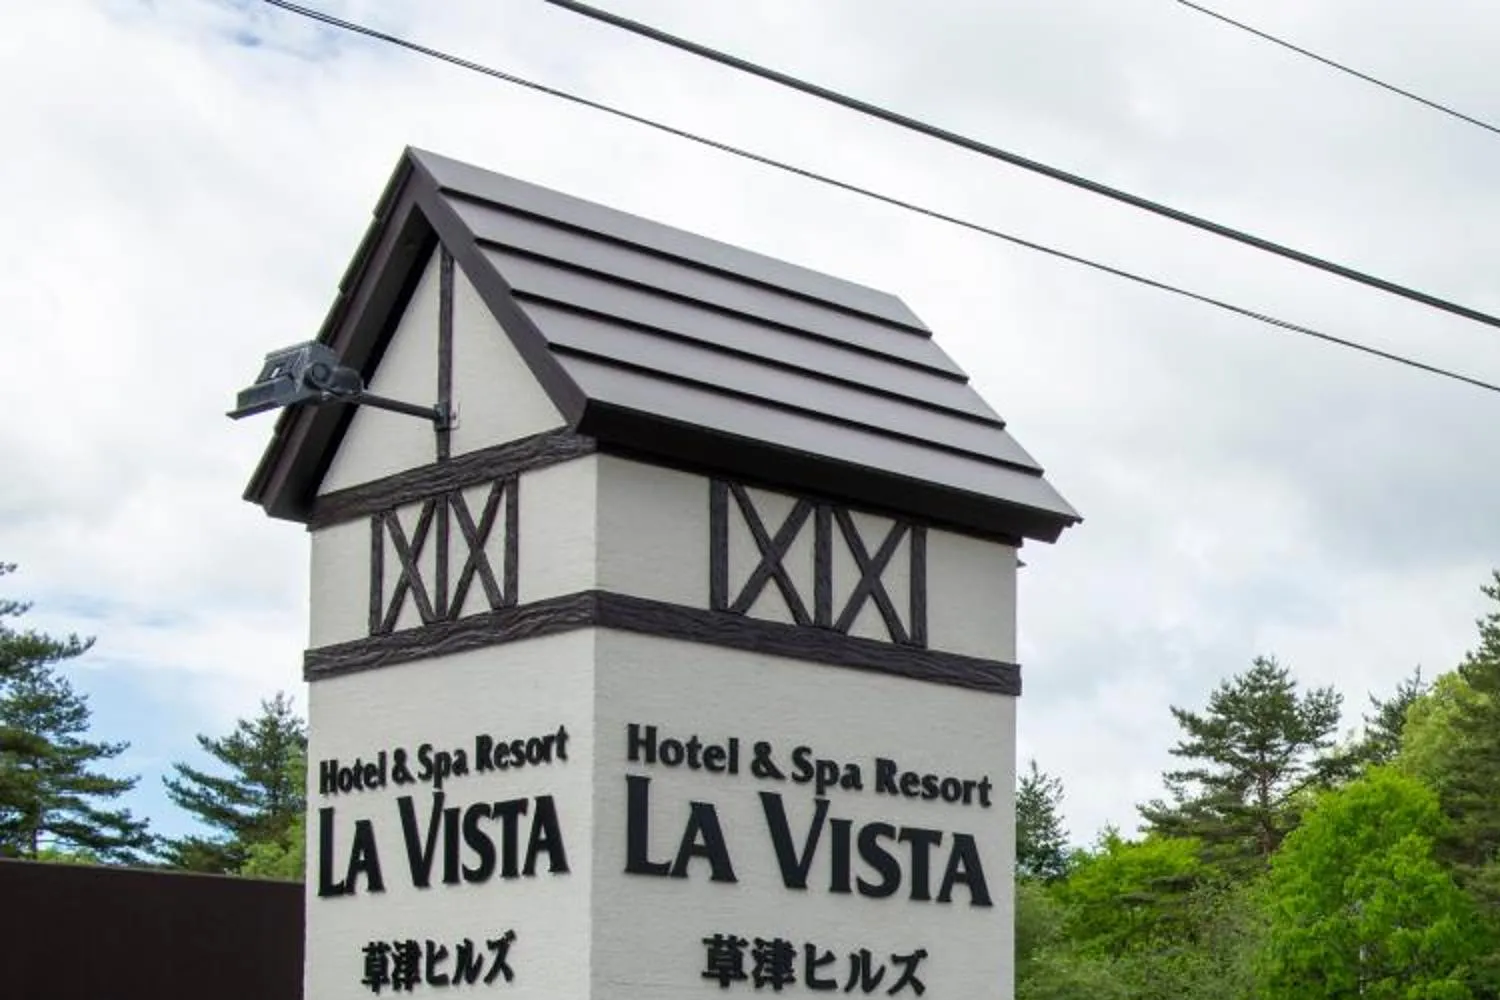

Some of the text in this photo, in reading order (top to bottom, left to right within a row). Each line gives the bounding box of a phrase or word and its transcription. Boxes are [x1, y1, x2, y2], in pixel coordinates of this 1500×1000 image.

[319, 725, 569, 797] Hotel & Spa Resort
[626, 723, 993, 809] Hotel & Spa Resort
[317, 790, 570, 900] LA VISTA
[623, 773, 994, 909] LA VISTA
[361, 929, 517, 995] 草津ヒルズ
[700, 933, 929, 998] 草津ヒルズ
